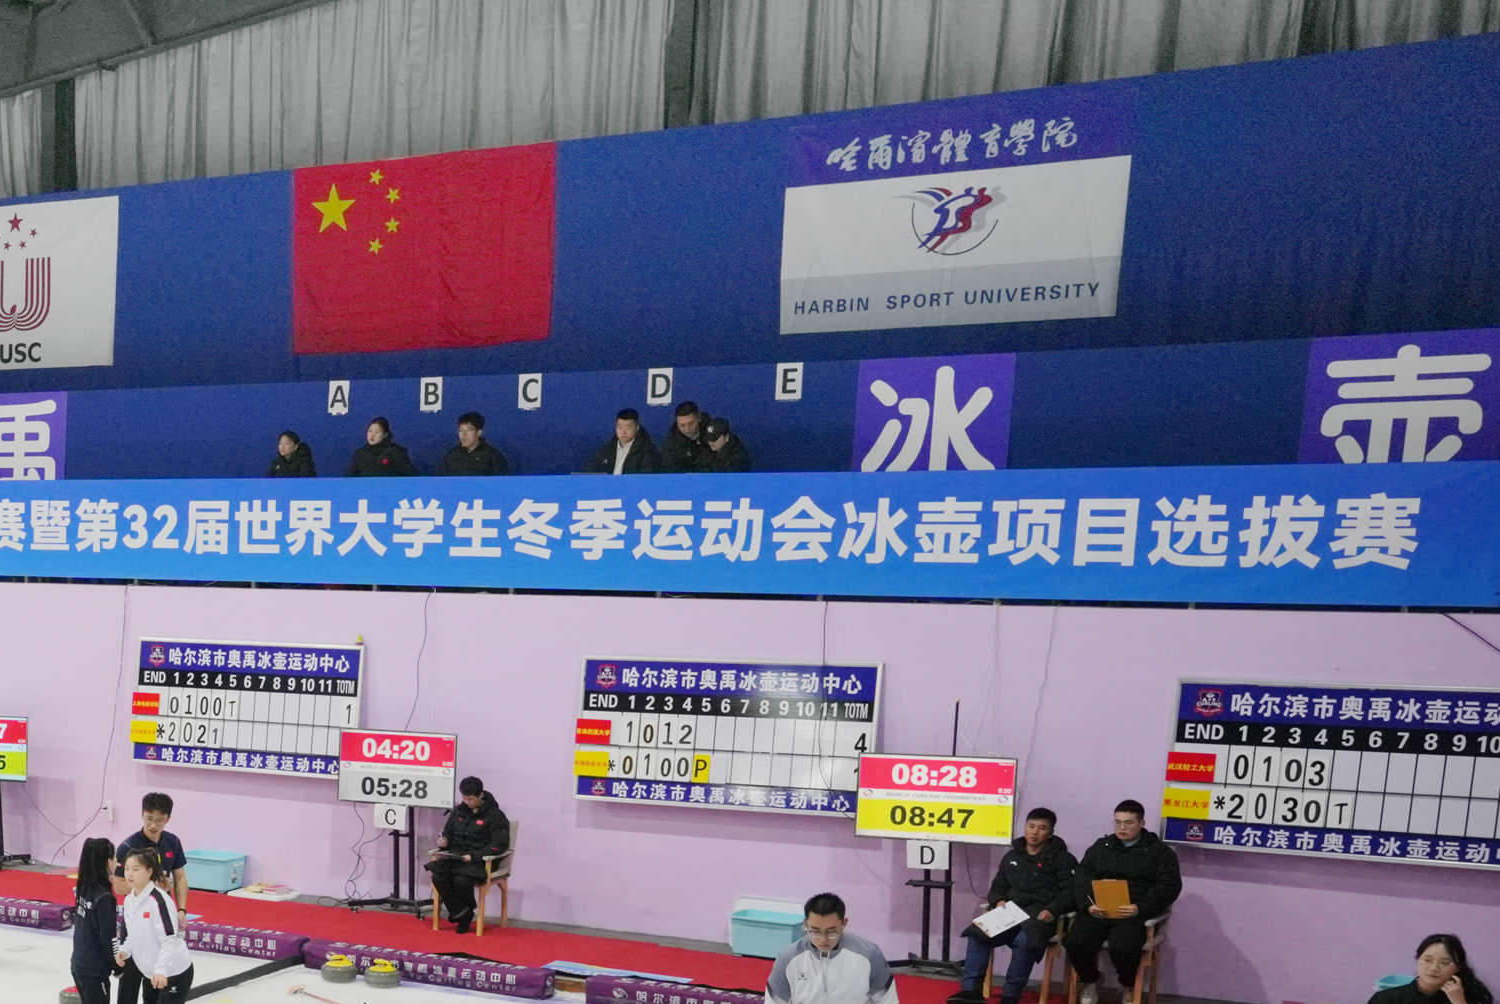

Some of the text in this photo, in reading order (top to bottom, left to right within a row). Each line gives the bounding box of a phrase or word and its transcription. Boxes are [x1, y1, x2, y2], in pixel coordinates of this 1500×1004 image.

[794, 281, 1100, 316] HARBIN SPORT UNIVERSITY
[522, 379, 538, 403] C
[651, 374, 670, 398] D
[782, 368, 797, 394] E
[330, 385, 347, 407] A
[424, 383, 439, 405] B
[860, 365, 996, 471] 冰
[169, 648, 350, 673] 哈尔滨市奥禹冰壶运动中心
[144, 671, 166, 683] END
[174, 672, 179, 684] 1
[187, 673, 194, 685] 2
[201, 673, 208, 685] 3
[215, 674, 222, 686] 4
[230, 675, 236, 687] 5
[244, 675, 251, 688] 6
[259, 676, 266, 689] 7
[273, 677, 281, 689] 8
[288, 678, 295, 690] 9
[301, 679, 315, 691] 10
[319, 679, 332, 692] 11
[622, 667, 862, 695] 哈尔滨市奥禹冰壶运动中心
[170, 695, 351, 724] 0 1 0 0 T 1
[589, 694, 618, 708] END
[629, 695, 635, 709] 1
[645, 696, 655, 710] 2
[664, 696, 673, 710] 3
[683, 697, 692, 711] 4
[702, 698, 711, 712] 5
[721, 699, 730, 713] 6
[741, 699, 750, 713] 7
[760, 700, 769, 714] 8
[779, 701, 789, 715] 9
[797, 702, 815, 716] 10
[821, 703, 837, 719] 11
[168, 722, 218, 744] 2 0 2 1
[627, 721, 869, 754] 1 0 1 2 4
[1185, 723, 1500, 753] END 1 2 3 4 5 6 7 8 9 10
[362, 738, 430, 761] 04:20
[623, 754, 707, 777] 0 1 0 0 P
[892, 764, 976, 788] 08:28
[1234, 755, 1248, 779] 0
[1264, 756, 1272, 782] 1
[1285, 759, 1302, 782] 0
[1309, 761, 1325, 786] 3
[362, 777, 428, 799] 05:28
[385, 809, 396, 825] C
[890, 806, 974, 828] 08:47
[1227, 794, 1244, 819] 2
[1255, 793, 1266, 819] 0
[1282, 797, 1298, 822] 3
[1304, 800, 1321, 823] 0
[1334, 803, 1348, 824] T
[921, 846, 934, 864] D
[1214, 826, 1500, 863] 哈尔滨市奥禹冰壶运动
